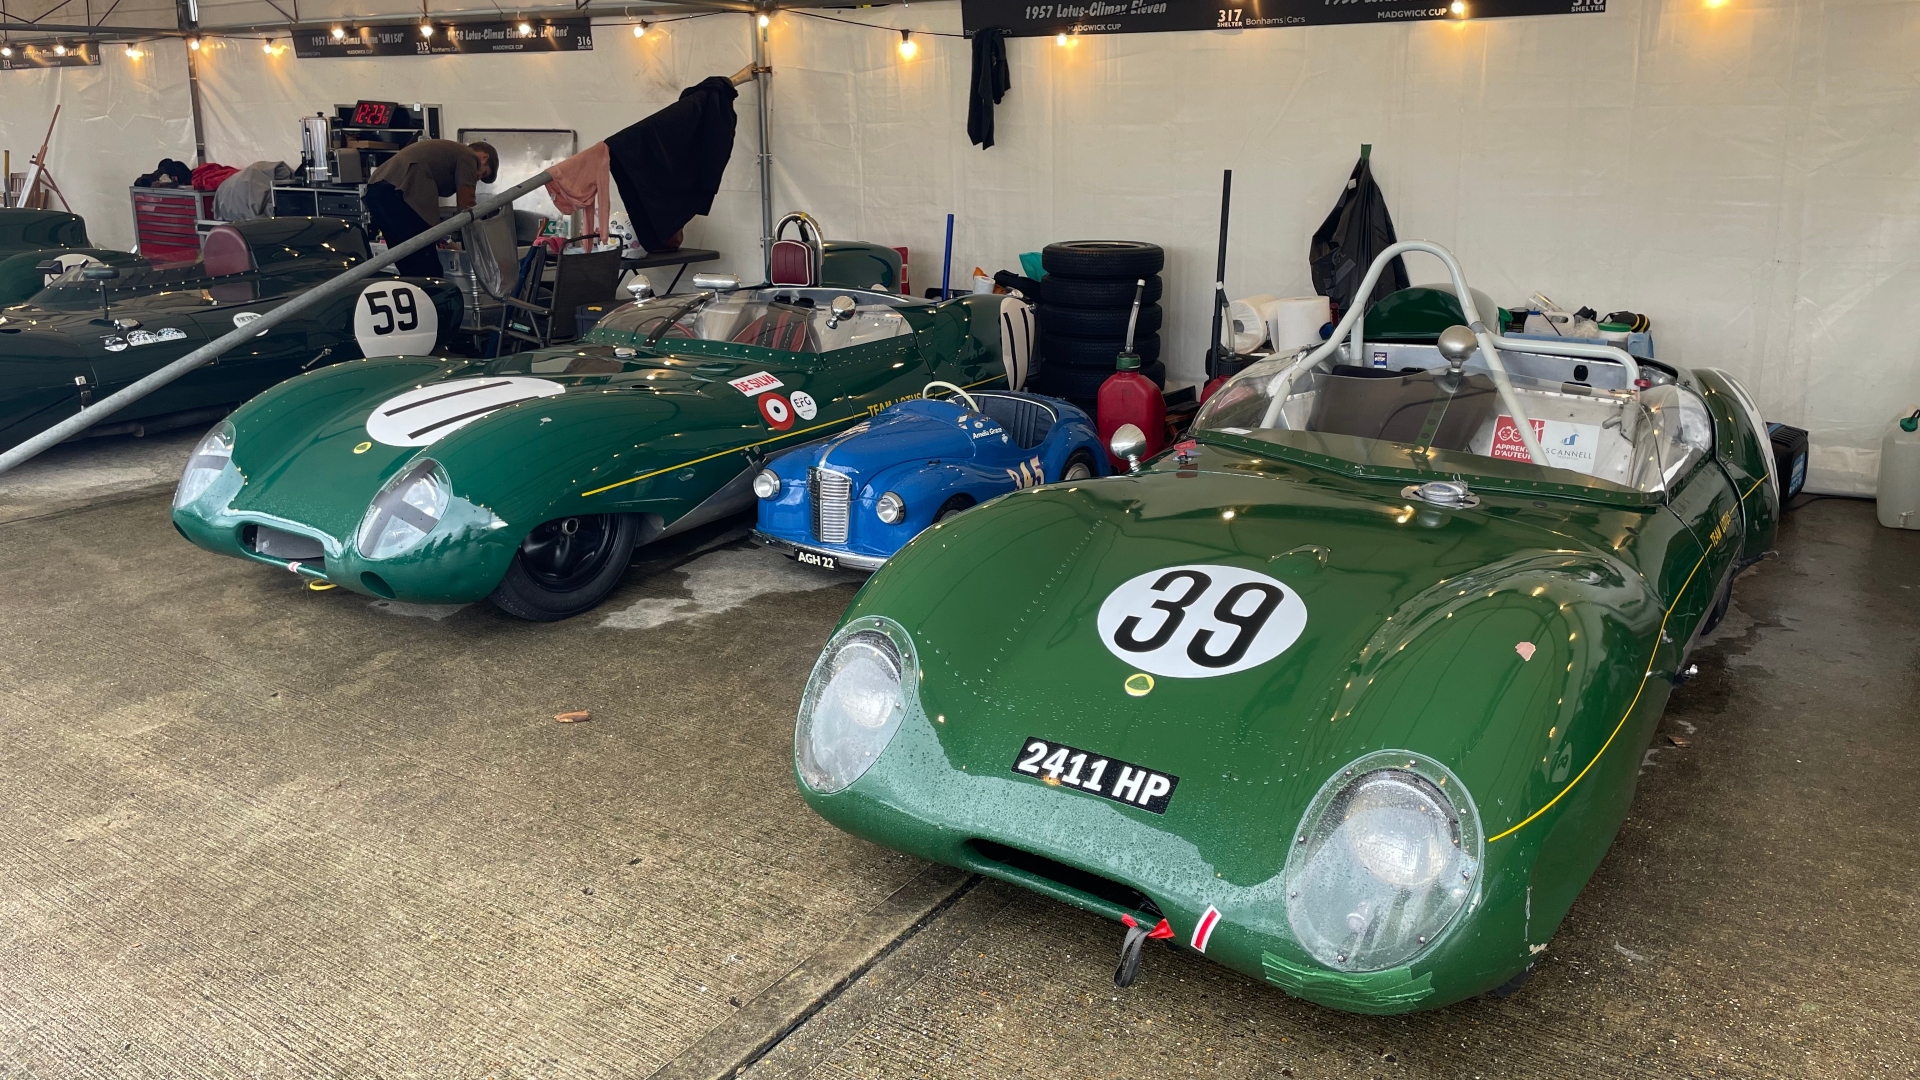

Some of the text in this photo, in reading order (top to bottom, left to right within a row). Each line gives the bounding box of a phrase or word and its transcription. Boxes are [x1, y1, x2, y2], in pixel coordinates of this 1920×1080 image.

[1025, 0, 1168, 20] 1957 Lotus-Climax Eleven
[1218, 8, 1243, 22] 317
[1377, 7, 1448, 19] MADGWICK CUP
[1570, 4, 1605, 13] SHELTER
[1245, 15, 1306, 26] Bonhams Cars
[1067, 23, 1122, 32] MADGWICK CUP
[465, 28, 505, 41] Lotus-Climax
[577, 36, 592, 46] 316
[311, 36, 325, 47] 1957
[415, 41, 429, 51] 315
[355, 103, 386, 125] 12:23
[364, 287, 419, 336] 59
[733, 374, 780, 393] DE SILVA
[793, 396, 812, 408] EFG
[383, 380, 541, 440] 11
[866, 400, 893, 418] TEAM
[972, 427, 1003, 440] Amelia Grace
[1495, 443, 1529, 453] APPRENT
[1545, 447, 1592, 460] SCANNELL
[1494, 450, 1532, 460] D'AUTEUI
[798, 551, 835, 569] AGH 22
[1113, 569, 1285, 669] 39
[1017, 741, 1171, 806] 2411 HP
